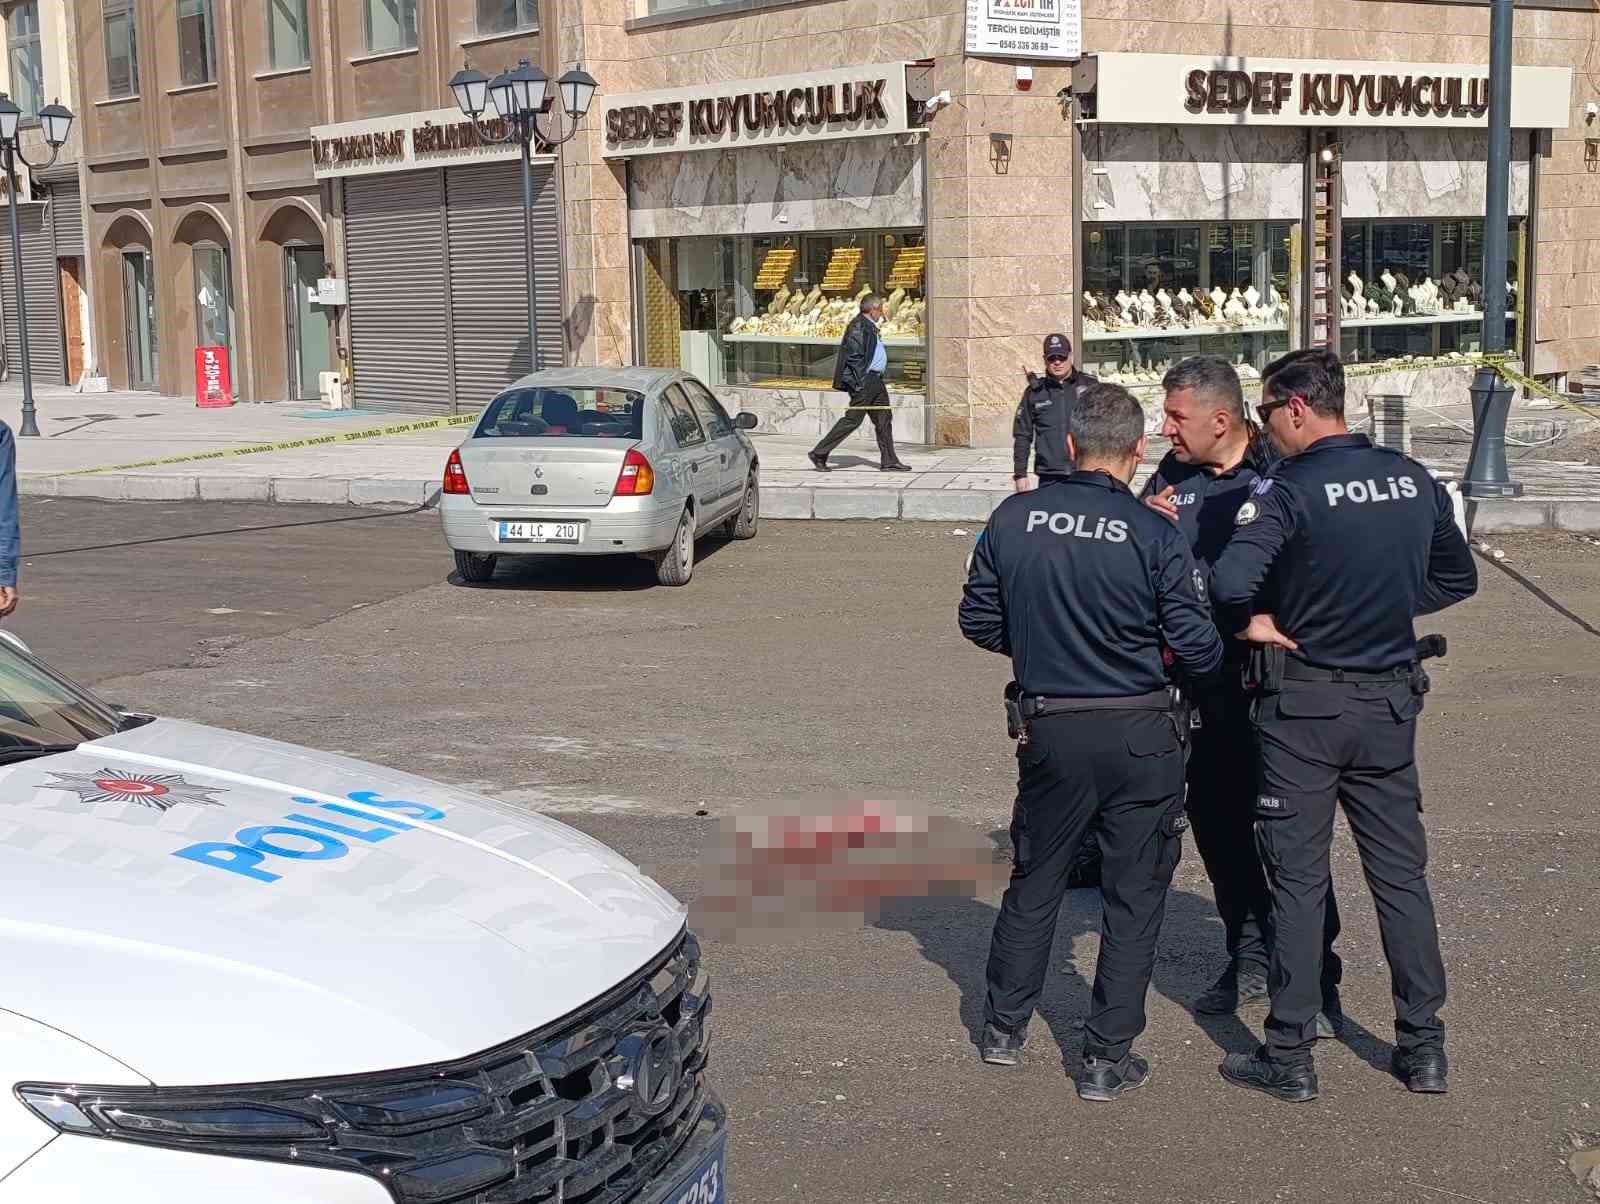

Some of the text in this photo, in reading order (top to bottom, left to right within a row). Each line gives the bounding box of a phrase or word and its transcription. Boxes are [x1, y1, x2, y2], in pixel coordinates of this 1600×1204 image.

[606, 79, 888, 145] SEDEF KUYUMCULUK
[1184, 69, 1489, 114] SEDEF KUYUMCULU
[509, 524, 574, 538] 44 LC 210
